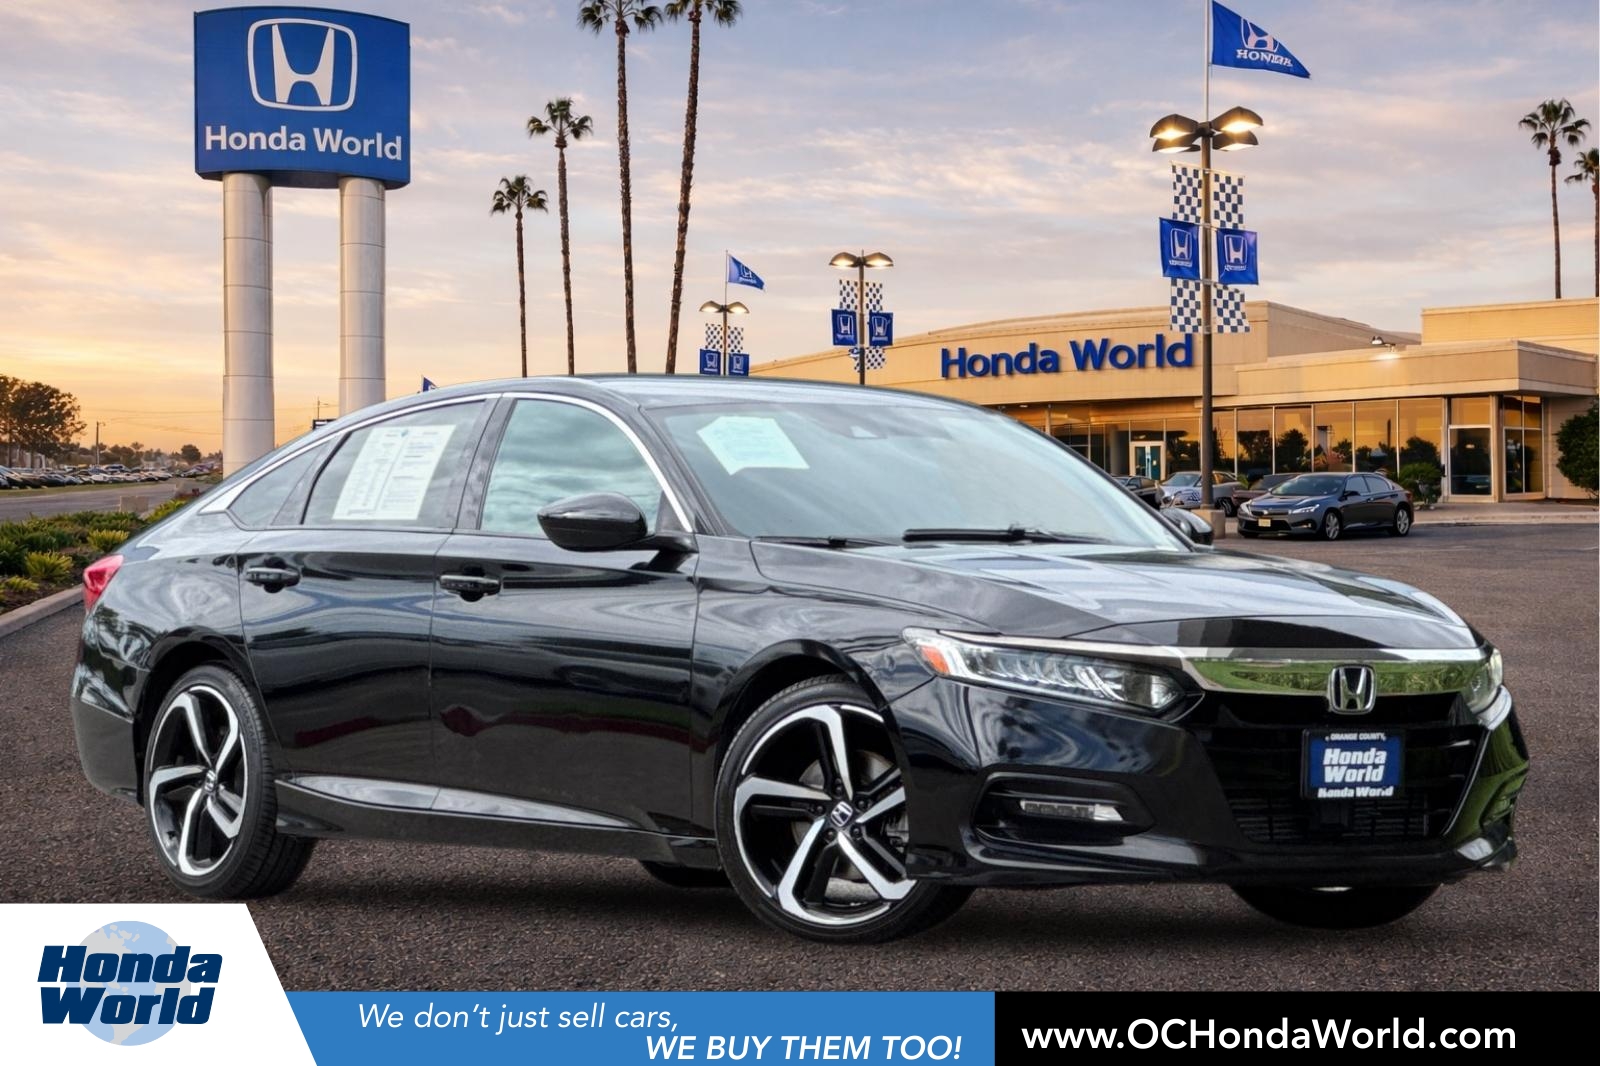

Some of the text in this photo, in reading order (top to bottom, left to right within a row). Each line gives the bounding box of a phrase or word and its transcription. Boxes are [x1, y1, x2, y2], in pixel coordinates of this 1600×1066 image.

[205, 125, 402, 160] Honda World
[941, 333, 1194, 379] Honda World
[1323, 747, 1387, 765] Honda
[1324, 765, 1384, 783] World
